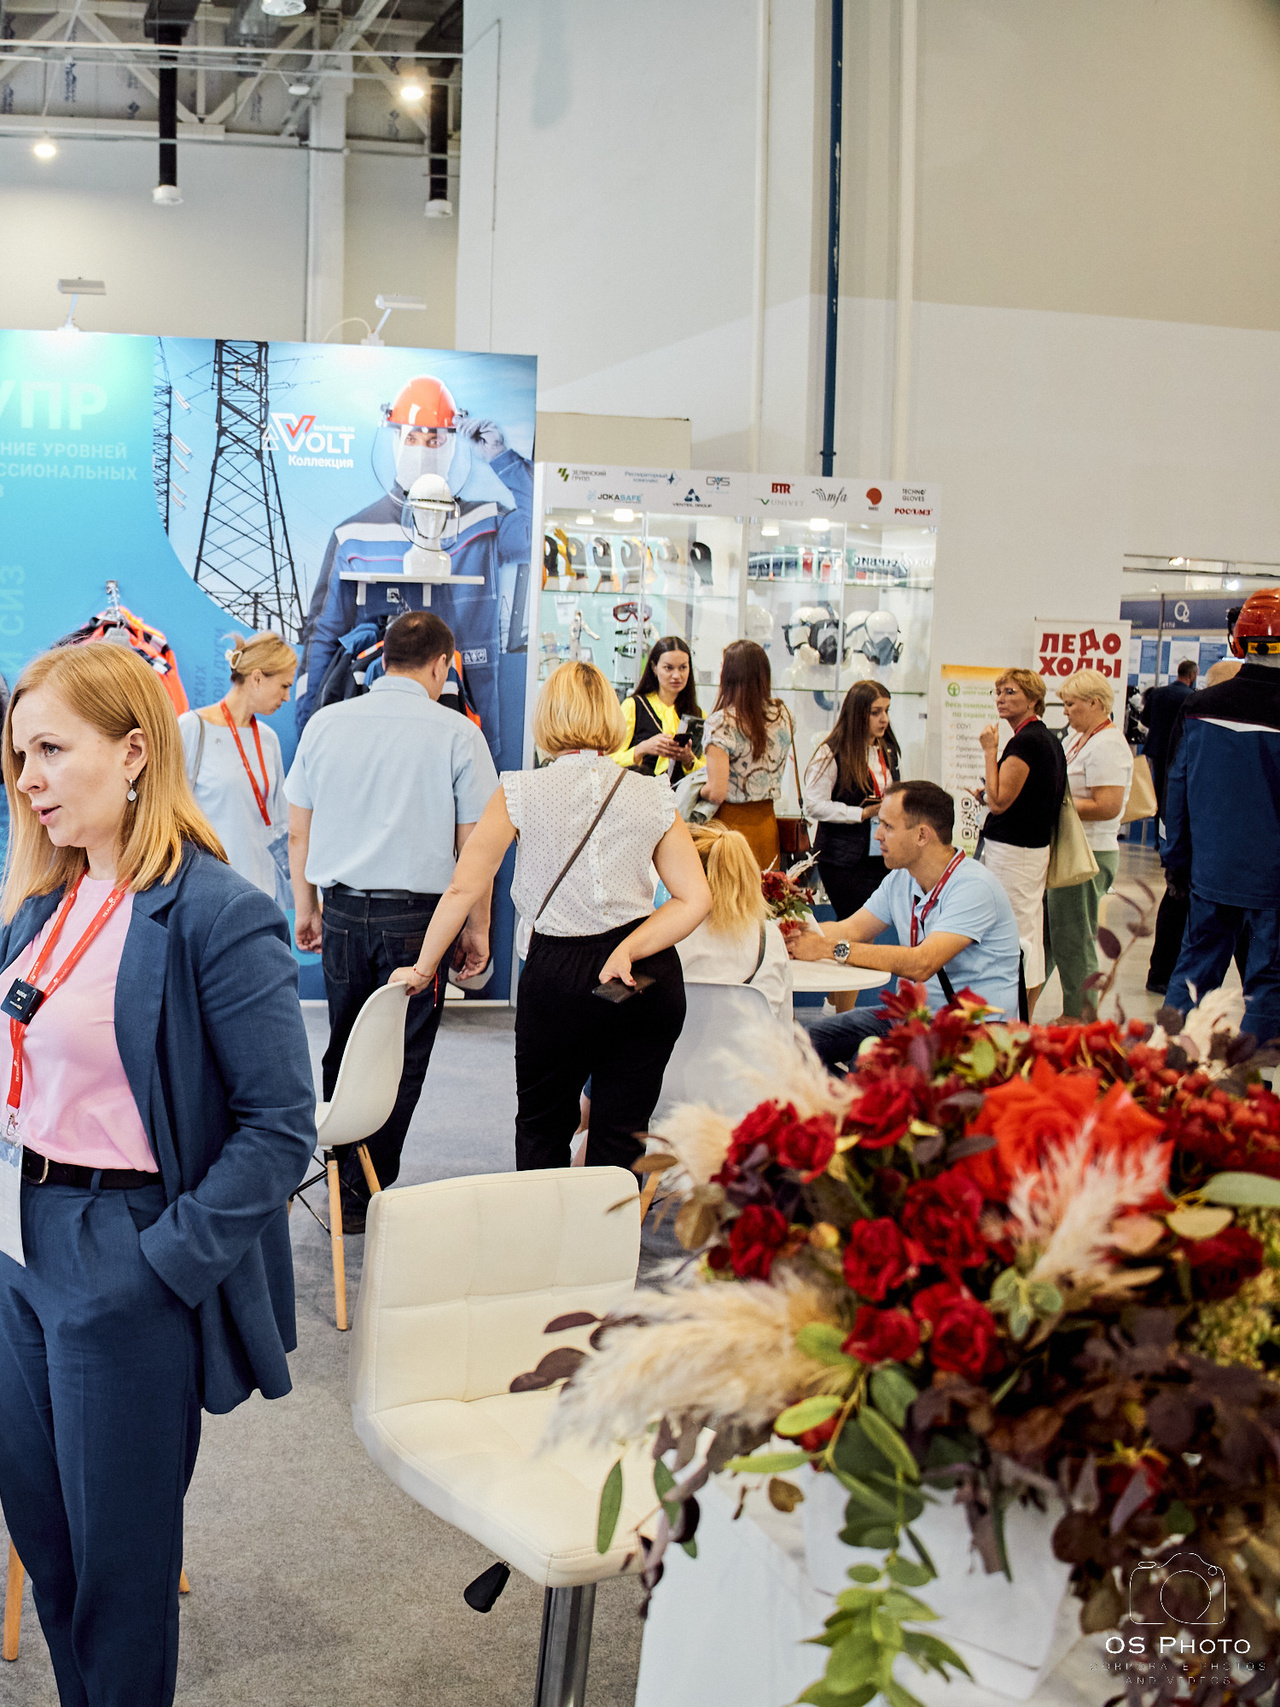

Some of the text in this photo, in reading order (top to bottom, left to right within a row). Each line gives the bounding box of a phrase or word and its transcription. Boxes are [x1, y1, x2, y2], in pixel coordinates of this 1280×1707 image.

[42, 441, 128, 460] УРОВНЕЙ
[288, 454, 354, 470] Коллекция
[572, 469, 607, 477] ЗЕЛИНСКИЙ
[771, 482, 791, 494] BTR
[597, 493, 642, 501] JOKASAFE
[1039, 628, 1121, 657] ЛЕДО
[1039, 656, 1122, 678] ХОДЫ
